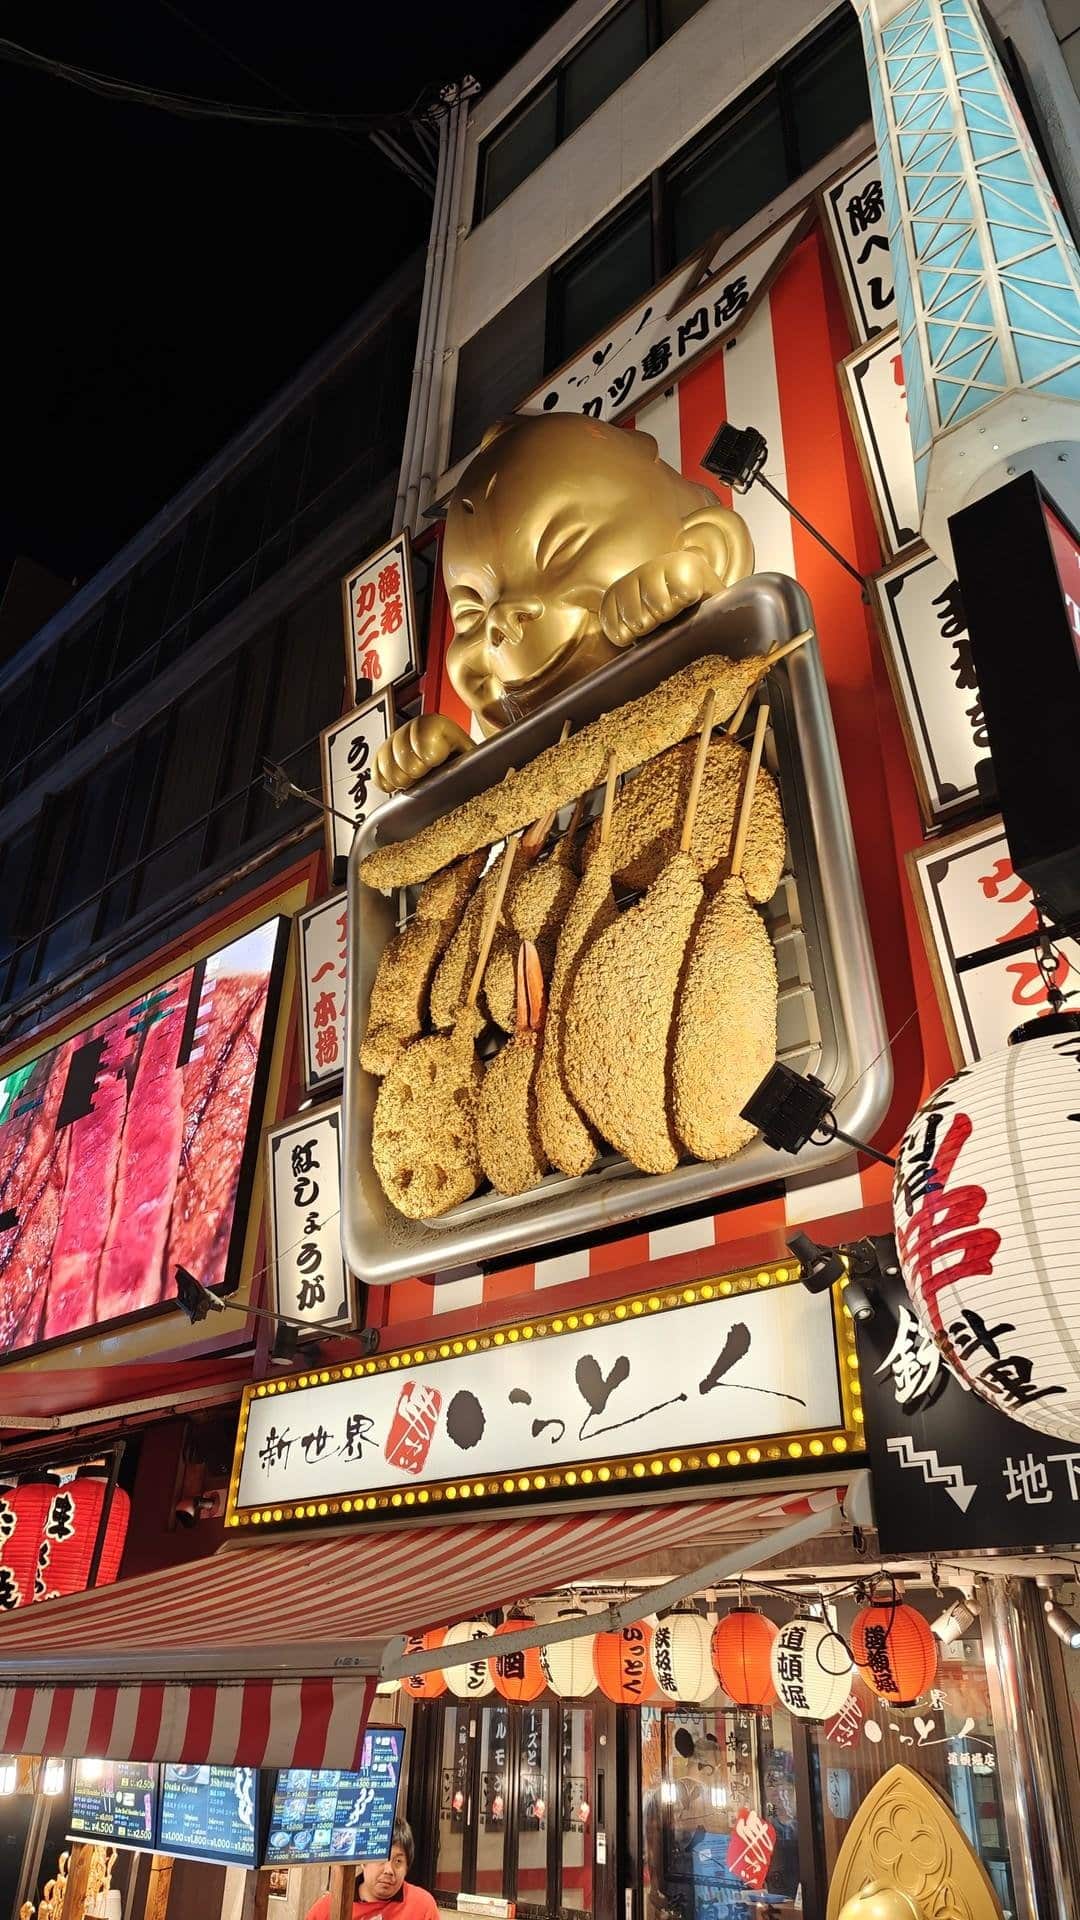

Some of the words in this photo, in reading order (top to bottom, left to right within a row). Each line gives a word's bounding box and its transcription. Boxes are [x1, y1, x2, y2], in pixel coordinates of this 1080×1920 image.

[311, 962, 338, 1068] 一本揚
[291, 1139, 326, 1312] 紅しょうが
[258, 1414, 380, 1478] 新世界
[1002, 1452, 1080, 1504] 地下
[623, 1627, 645, 1695] いっとく
[777, 1626, 810, 1710] 道頓堀
[865, 1625, 899, 1693] 道頓堀
